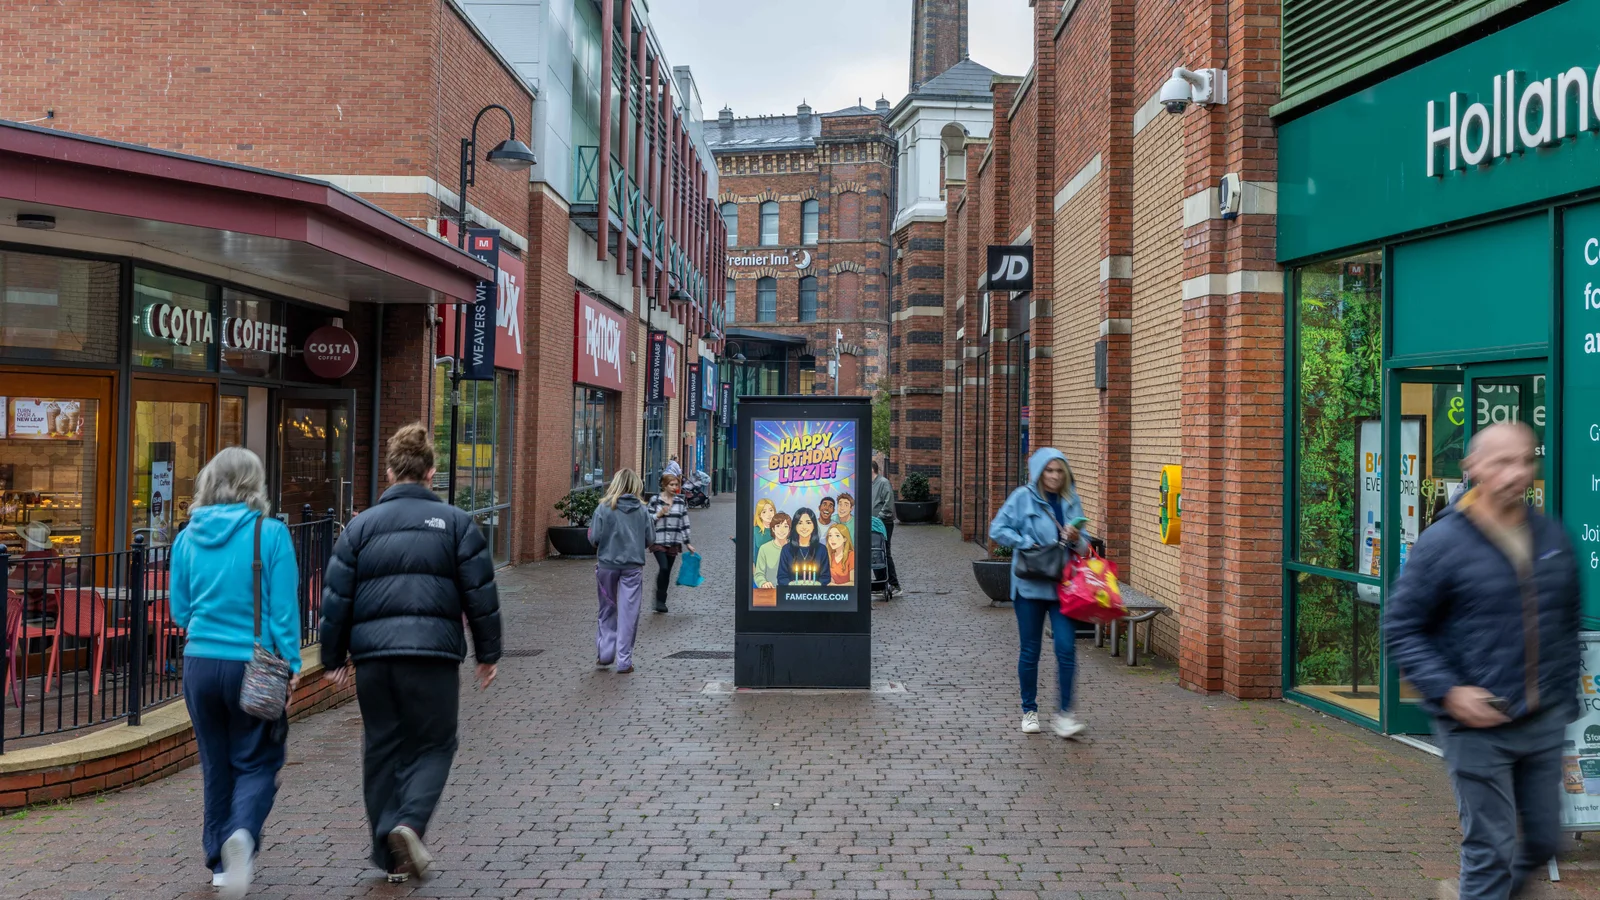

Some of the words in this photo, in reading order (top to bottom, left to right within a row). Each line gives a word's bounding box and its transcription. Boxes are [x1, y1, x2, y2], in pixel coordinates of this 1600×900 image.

[770, 254, 788, 264] Inn
[1584, 238, 1600, 266] C
[476, 254, 487, 303] WHF
[992, 256, 1029, 281] JD
[159, 303, 214, 346] COSTA
[234, 317, 288, 354] COFFEE
[472, 304, 486, 366] WEAVERS
[309, 342, 350, 354] COSTA
[780, 432, 834, 454] HAPPY
[1590, 424, 1600, 442] G
[769, 446, 843, 470] BIRTHDAY
[779, 462, 838, 483] LIZZIE!
[1366, 477, 1380, 492] EVE
[1582, 524, 1600, 542] Joi
[1590, 551, 1599, 568] &
